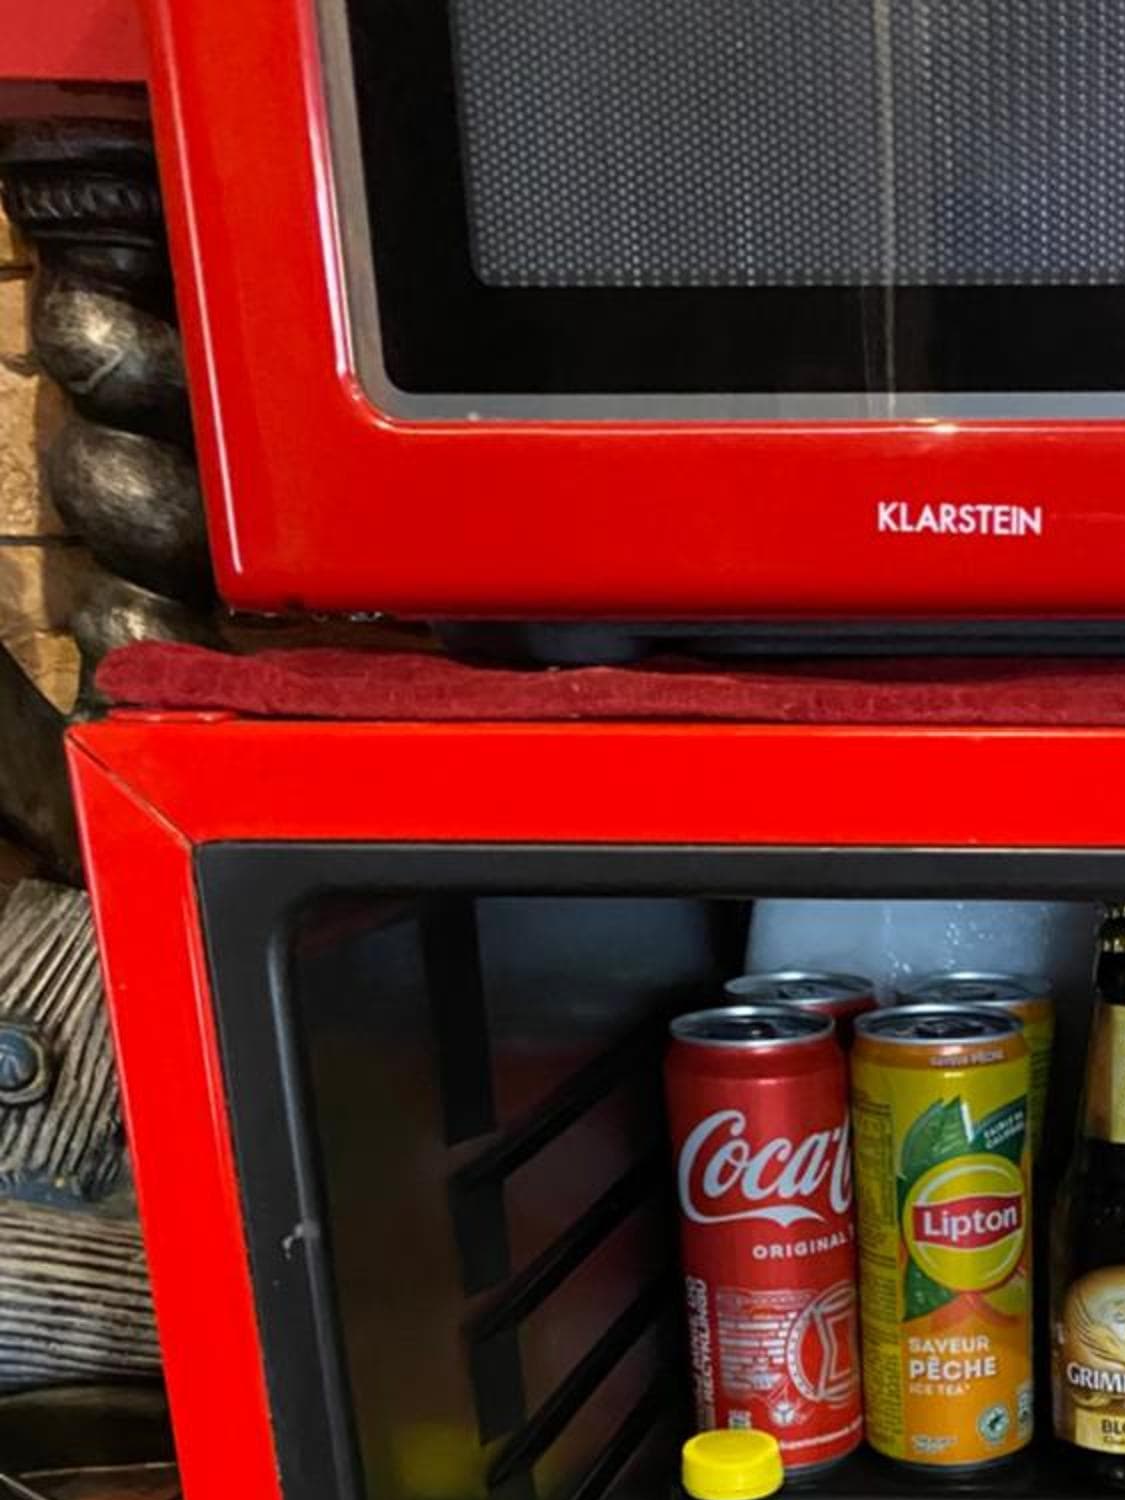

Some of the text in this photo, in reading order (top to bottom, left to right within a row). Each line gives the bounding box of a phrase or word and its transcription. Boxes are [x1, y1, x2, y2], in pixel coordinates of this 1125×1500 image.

[877, 501, 1042, 535] KLARSTEIN
[923, 1205, 1018, 1242] Lipton
[752, 1231, 849, 1260] ORIGINAL
[908, 1335, 990, 1354] SAVEUR
[909, 1353, 998, 1381] PÊCHE
